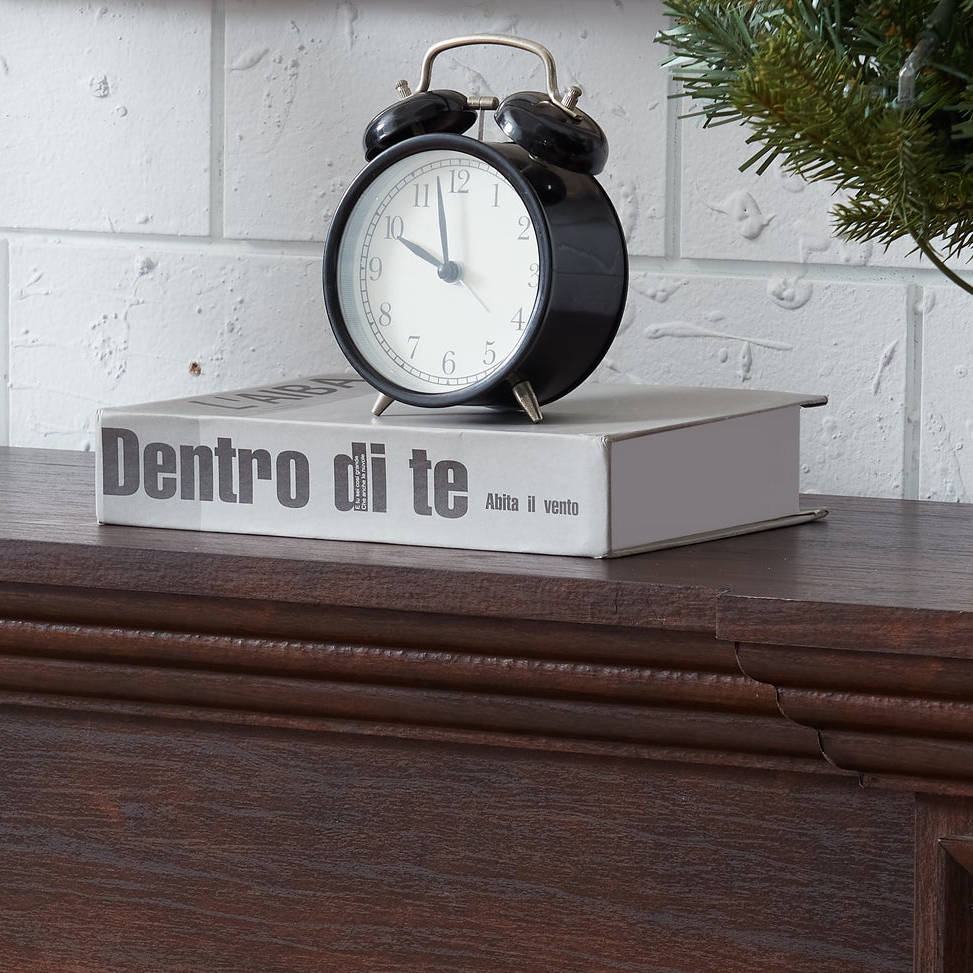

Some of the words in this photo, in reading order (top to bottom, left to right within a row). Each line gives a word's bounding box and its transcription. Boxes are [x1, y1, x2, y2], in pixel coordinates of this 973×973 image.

[448, 169, 470, 193] 12
[412, 183, 430, 208] 11
[492, 183, 500, 207] 1
[384, 215, 404, 240] 10
[517, 216, 530, 240] 2
[369, 257, 382, 281] 9
[528, 263, 540, 288] 3
[379, 302, 392, 326] 8
[510, 307, 525, 331] 4
[407, 336, 420, 359] 7
[483, 340, 496, 365] 5
[442, 351, 456, 375] 6
[101, 427, 310, 509] Dentro
[333, 442, 387, 513] di
[409, 448, 469, 519] te
[485, 492, 519, 512] Abita
[528, 496, 536, 512] il
[544, 499, 579, 516] vento
